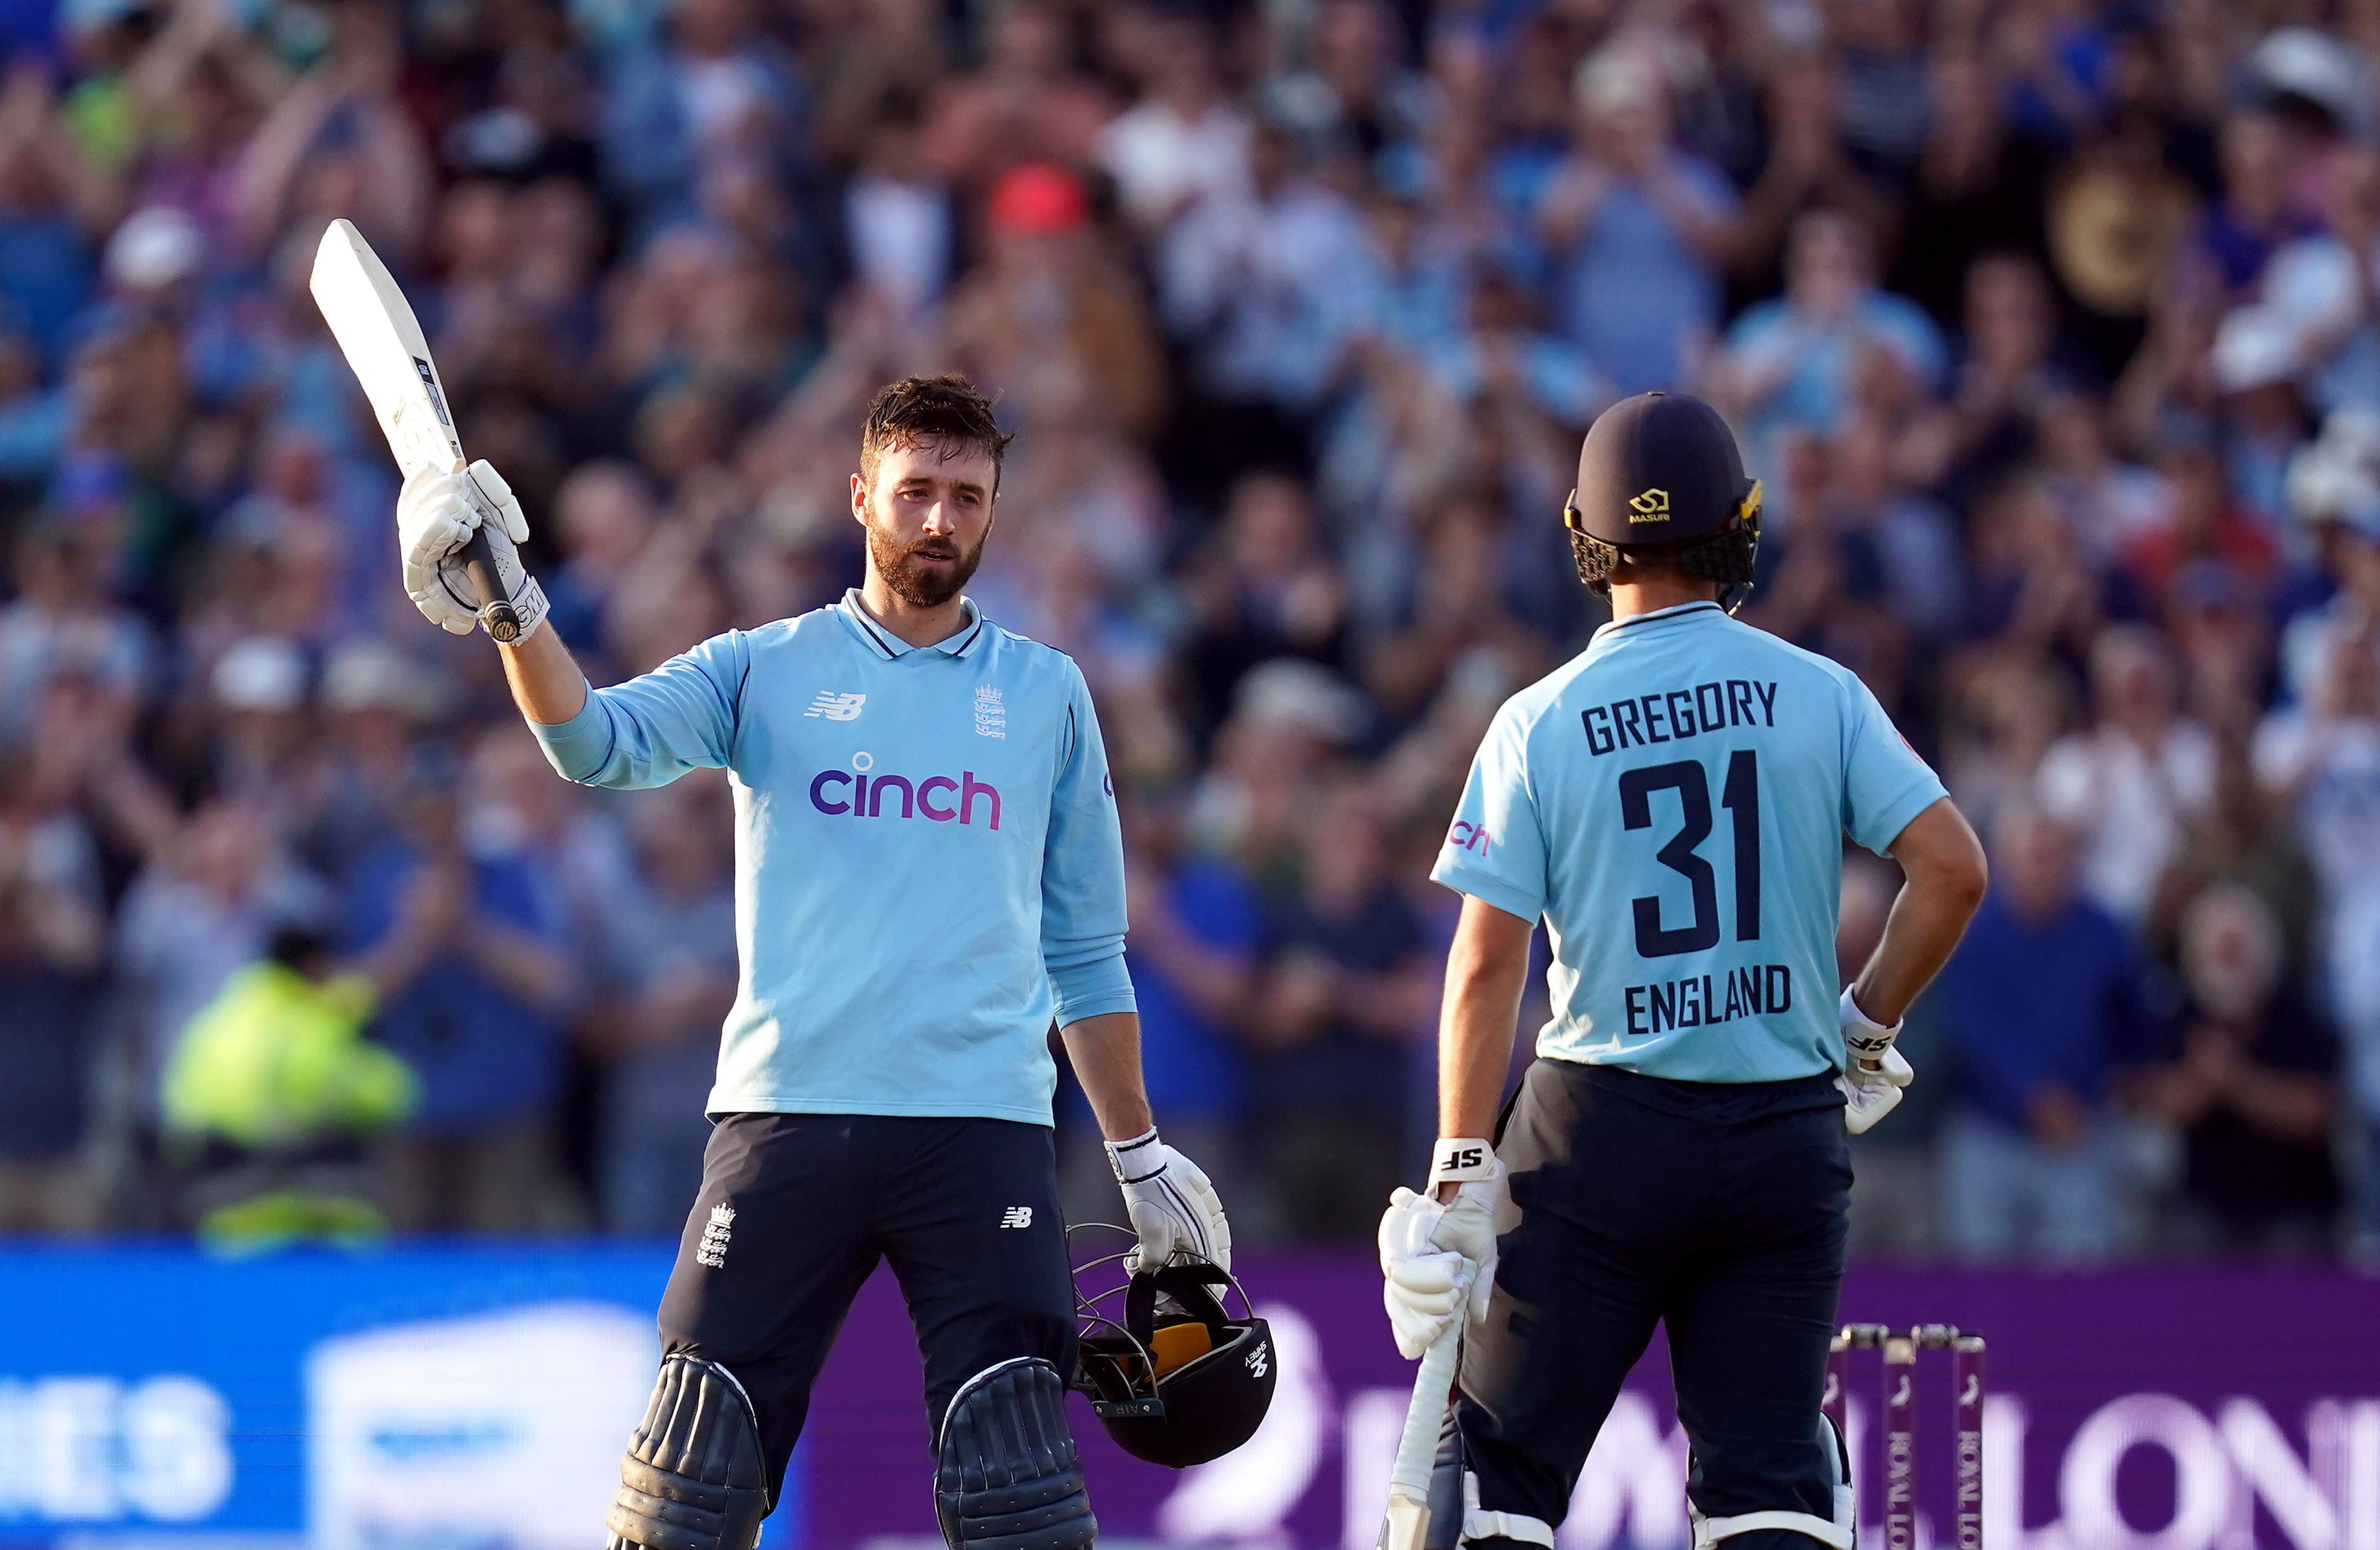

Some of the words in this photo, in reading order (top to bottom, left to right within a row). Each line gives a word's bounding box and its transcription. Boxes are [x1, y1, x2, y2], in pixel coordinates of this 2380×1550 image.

[1630, 513, 1670, 523] MASURI
[1582, 679, 1777, 756] GREGORY
[809, 751, 1001, 831] cinch
[1618, 750, 1761, 958] 31
[1625, 964, 1792, 1035] ENGLAND
[1848, 1035, 1892, 1052] SF
[1440, 1148, 1483, 1171] SF
[1245, 1340, 1268, 1368] SHREY
[0, 1373, 235, 1521] ES
[1977, 1390, 2380, 1550] LON
[1886, 1514, 1912, 1550] LO
[1957, 1513, 1982, 1550] LO
